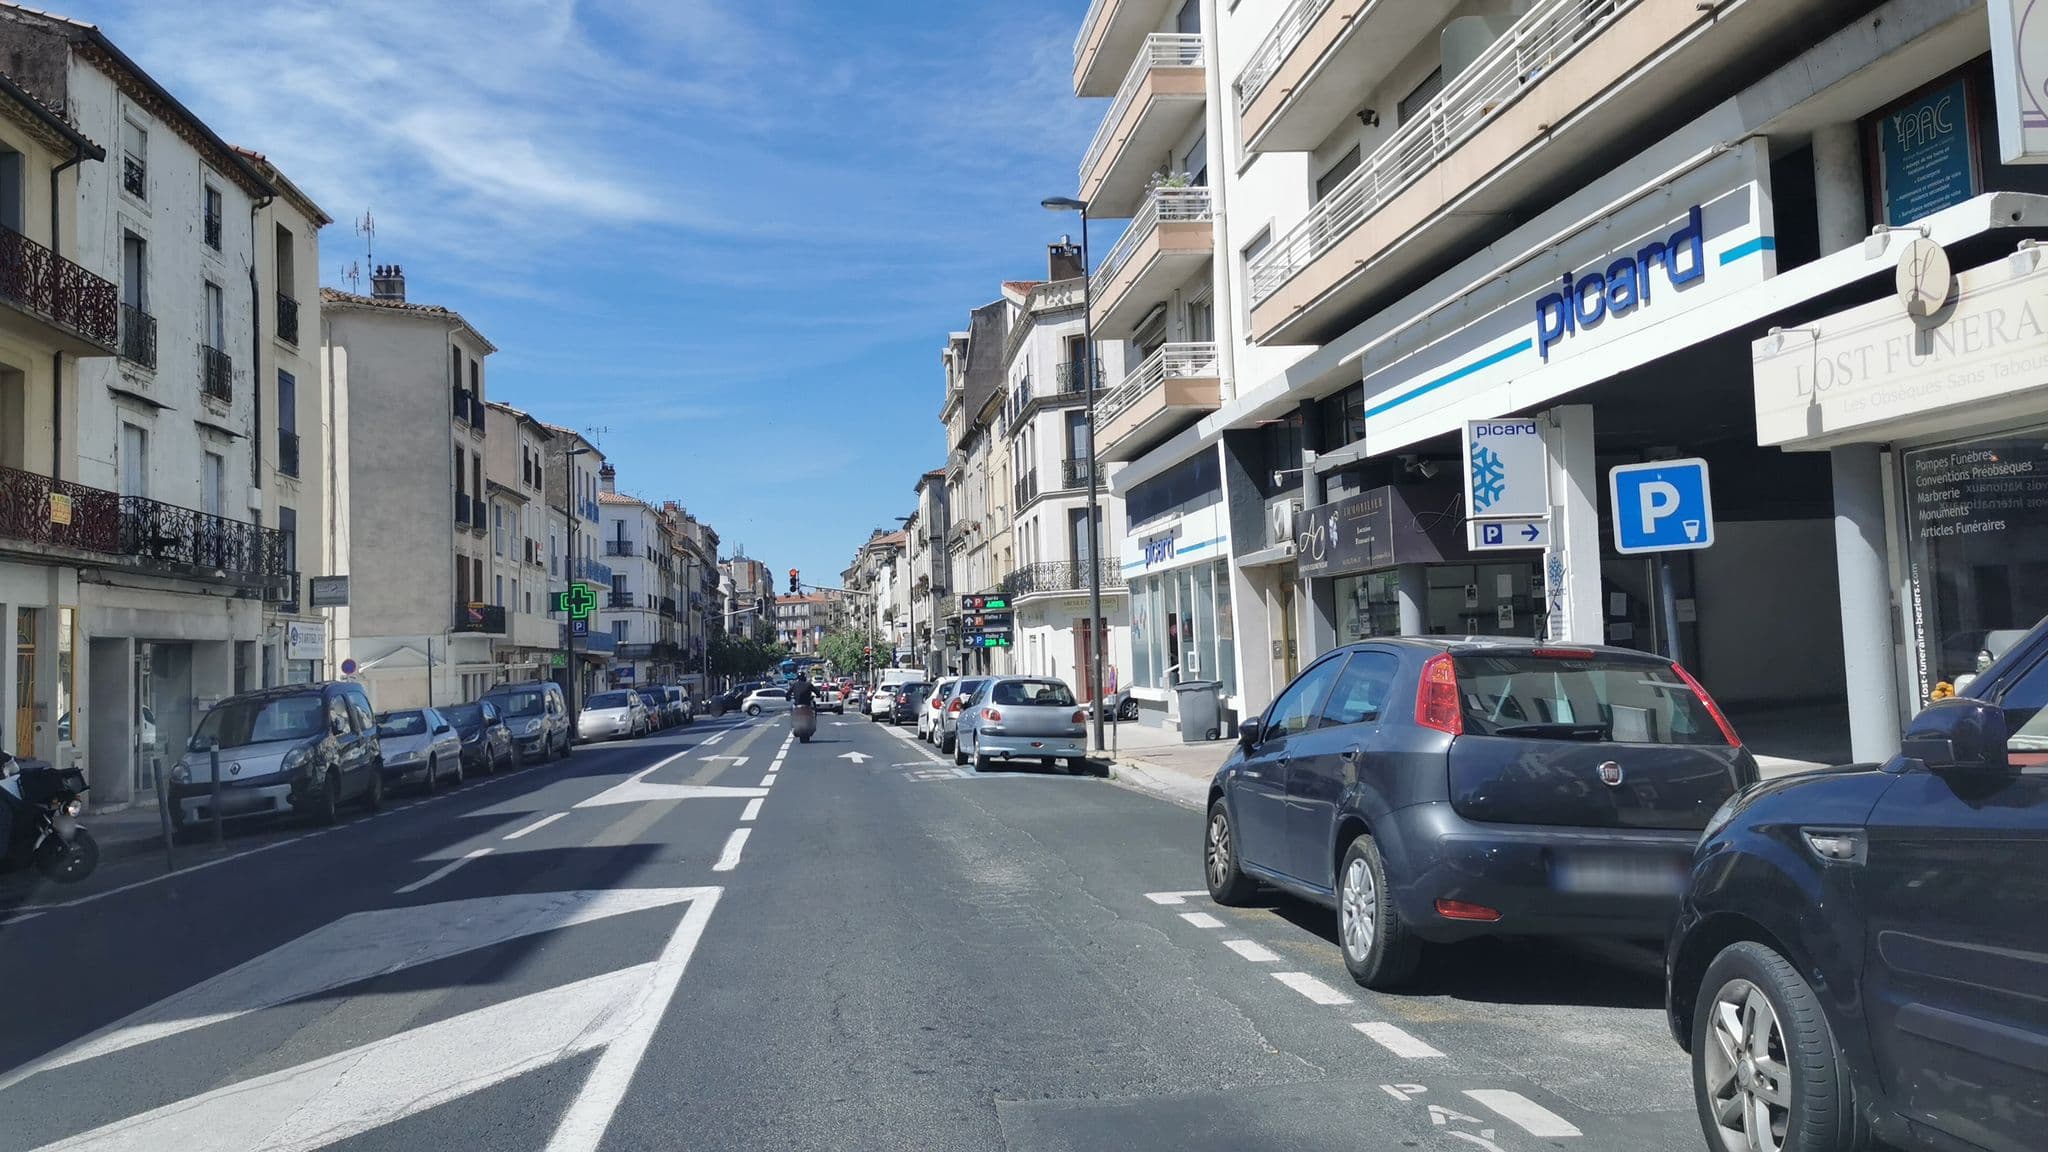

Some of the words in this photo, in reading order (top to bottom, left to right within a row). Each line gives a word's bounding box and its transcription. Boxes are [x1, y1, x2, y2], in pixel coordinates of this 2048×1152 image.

[1536, 205, 1704, 360] picard
[1795, 344, 1874, 397] LOST
[1885, 293, 2048, 374] FUNERA
[1842, 398, 1866, 413] Les
[1947, 368, 1985, 389] Sans
[1477, 422, 1537, 438] picard
[1915, 457, 1949, 472] Pompes
[1916, 470, 1970, 487] Conventions
[1917, 487, 1960, 503] Marbrerie
[1639, 481, 1680, 534] P
[1919, 505, 1969, 520] Monuments
[1487, 526, 1499, 542] P
[1921, 525, 1954, 538] Articles
[1956, 519, 2006, 534] Funéraires
[1145, 529, 1174, 570] picard
